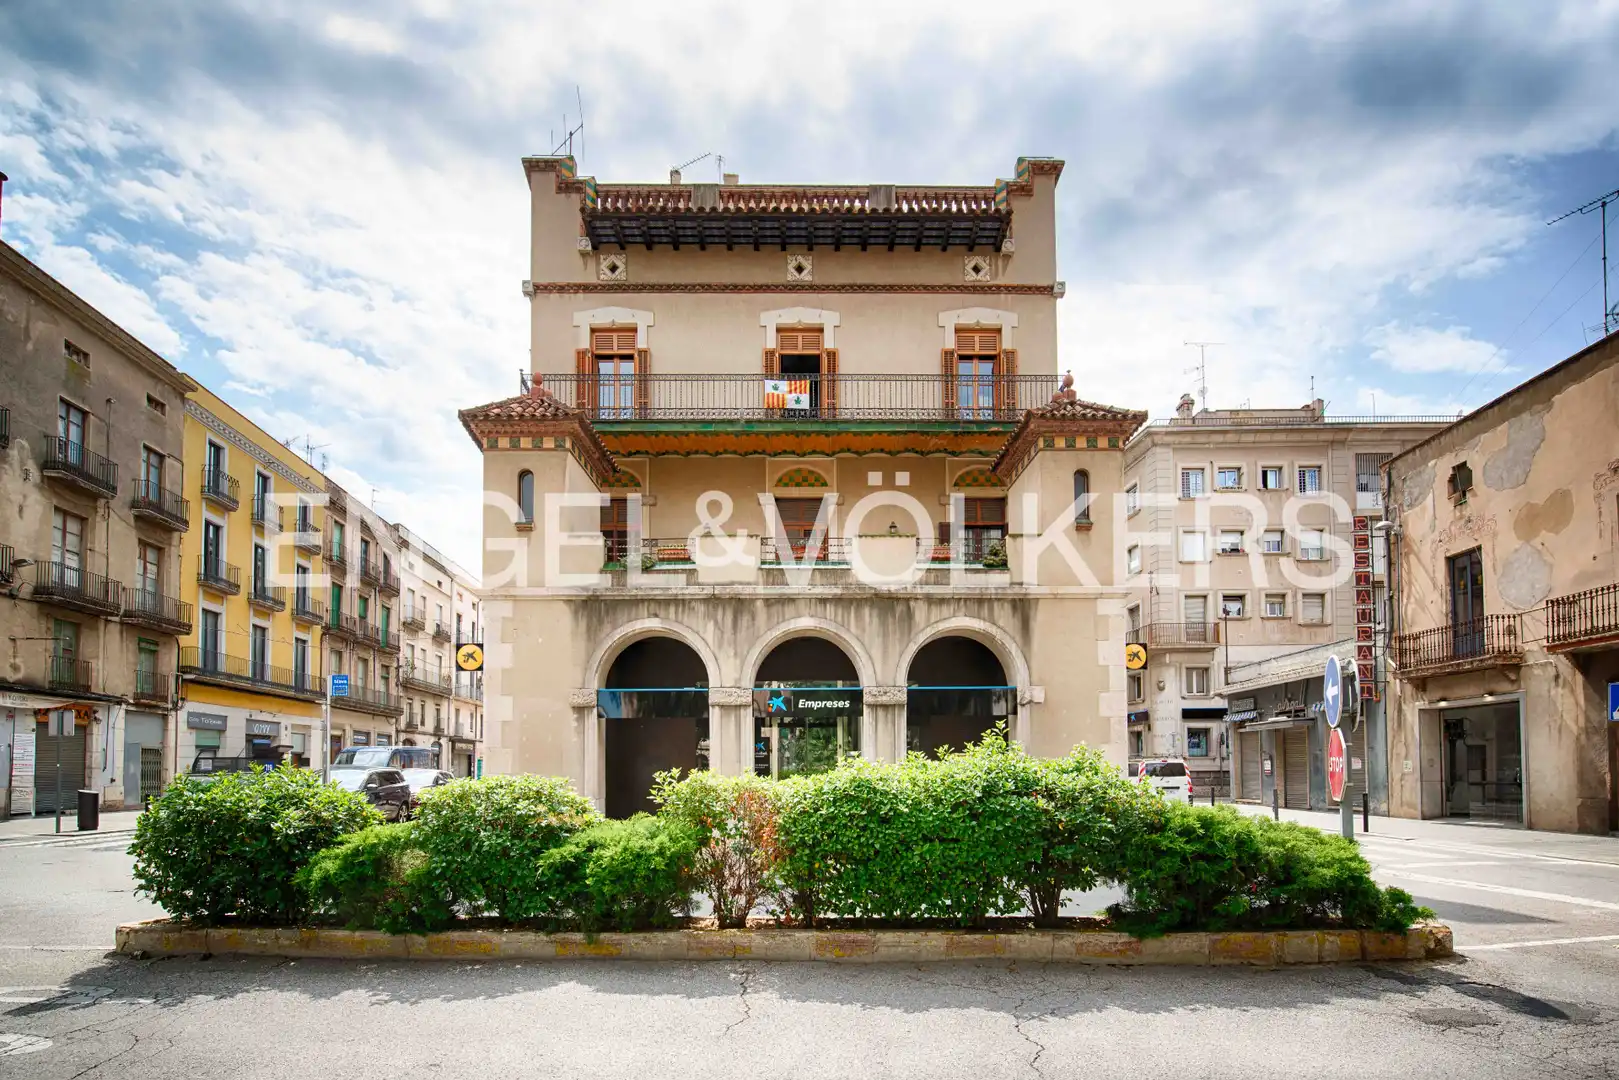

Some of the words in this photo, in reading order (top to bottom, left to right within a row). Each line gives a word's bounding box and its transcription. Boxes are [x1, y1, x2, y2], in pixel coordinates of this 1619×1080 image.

[1353, 516, 1374, 697] RESTAURANT
[798, 698, 850, 710] Empreses
[1329, 756, 1343, 773] STOP
